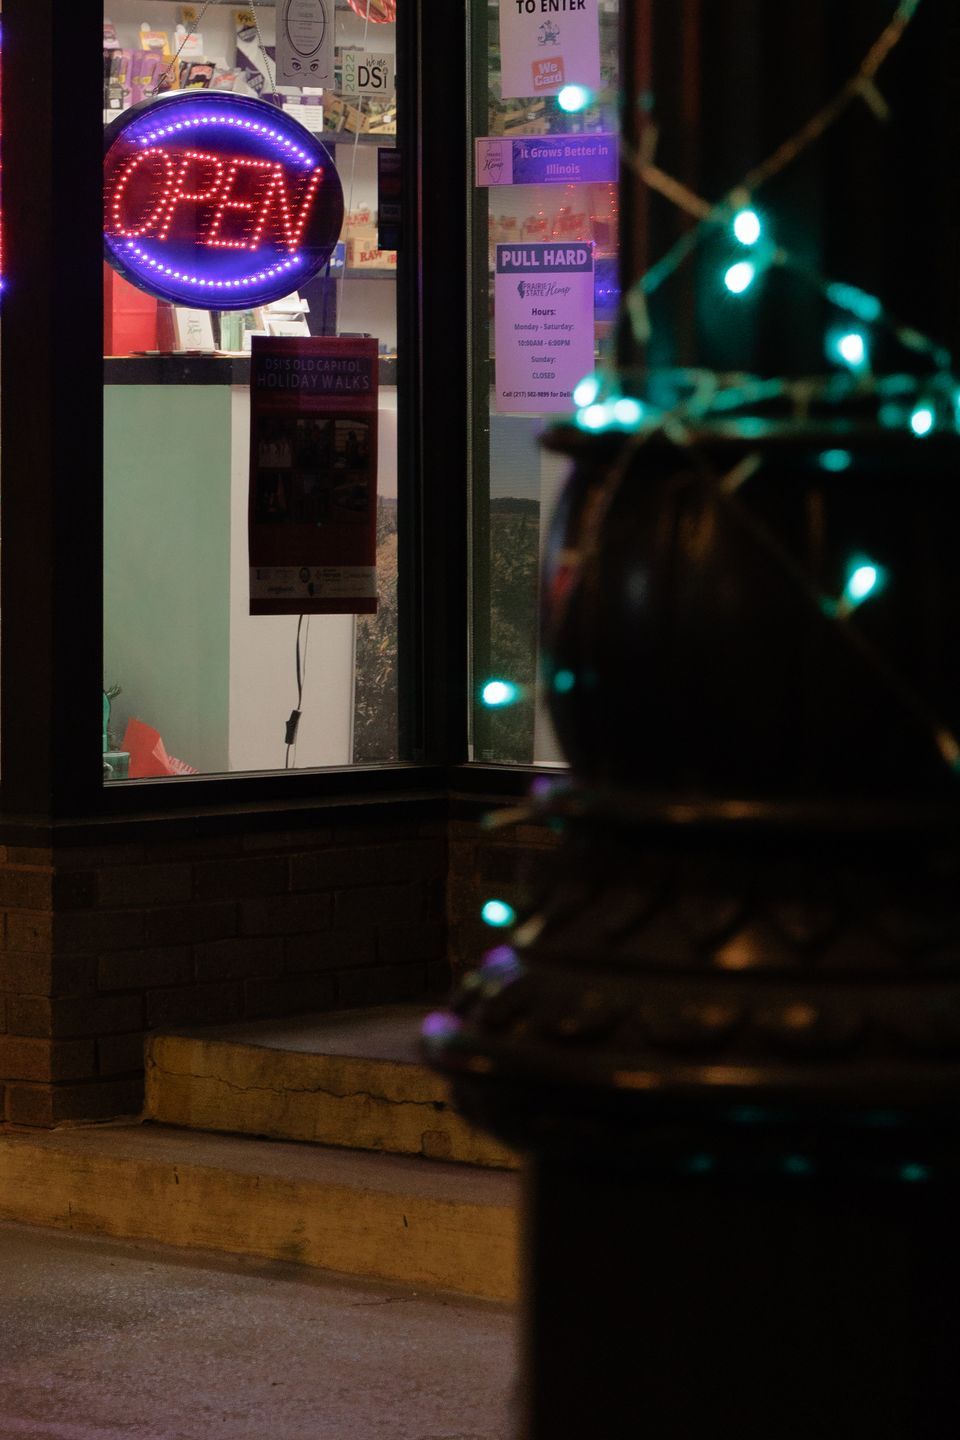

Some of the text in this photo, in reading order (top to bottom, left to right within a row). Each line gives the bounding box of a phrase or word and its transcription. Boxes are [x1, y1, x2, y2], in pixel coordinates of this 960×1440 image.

[516, 0, 536, 14] TO
[345, 53, 355, 92] 2022
[539, 61, 559, 74] We
[534, 72, 563, 86] Card
[520, 144, 609, 159] It Grows Better in
[546, 163, 581, 176] Illinois
[114, 147, 324, 253] OPEN
[360, 250, 383, 262] RAW
[502, 249, 588, 267] PULL HARD
[523, 281, 571, 297] PRAIRIE Hemp
[525, 289, 545, 297] STATE
[531, 308, 556, 317] Hours:
[514, 323, 538, 332] Monday
[257, 372, 370, 390] HOLIDAY WALKS
[559, 390, 573, 398] Deli
